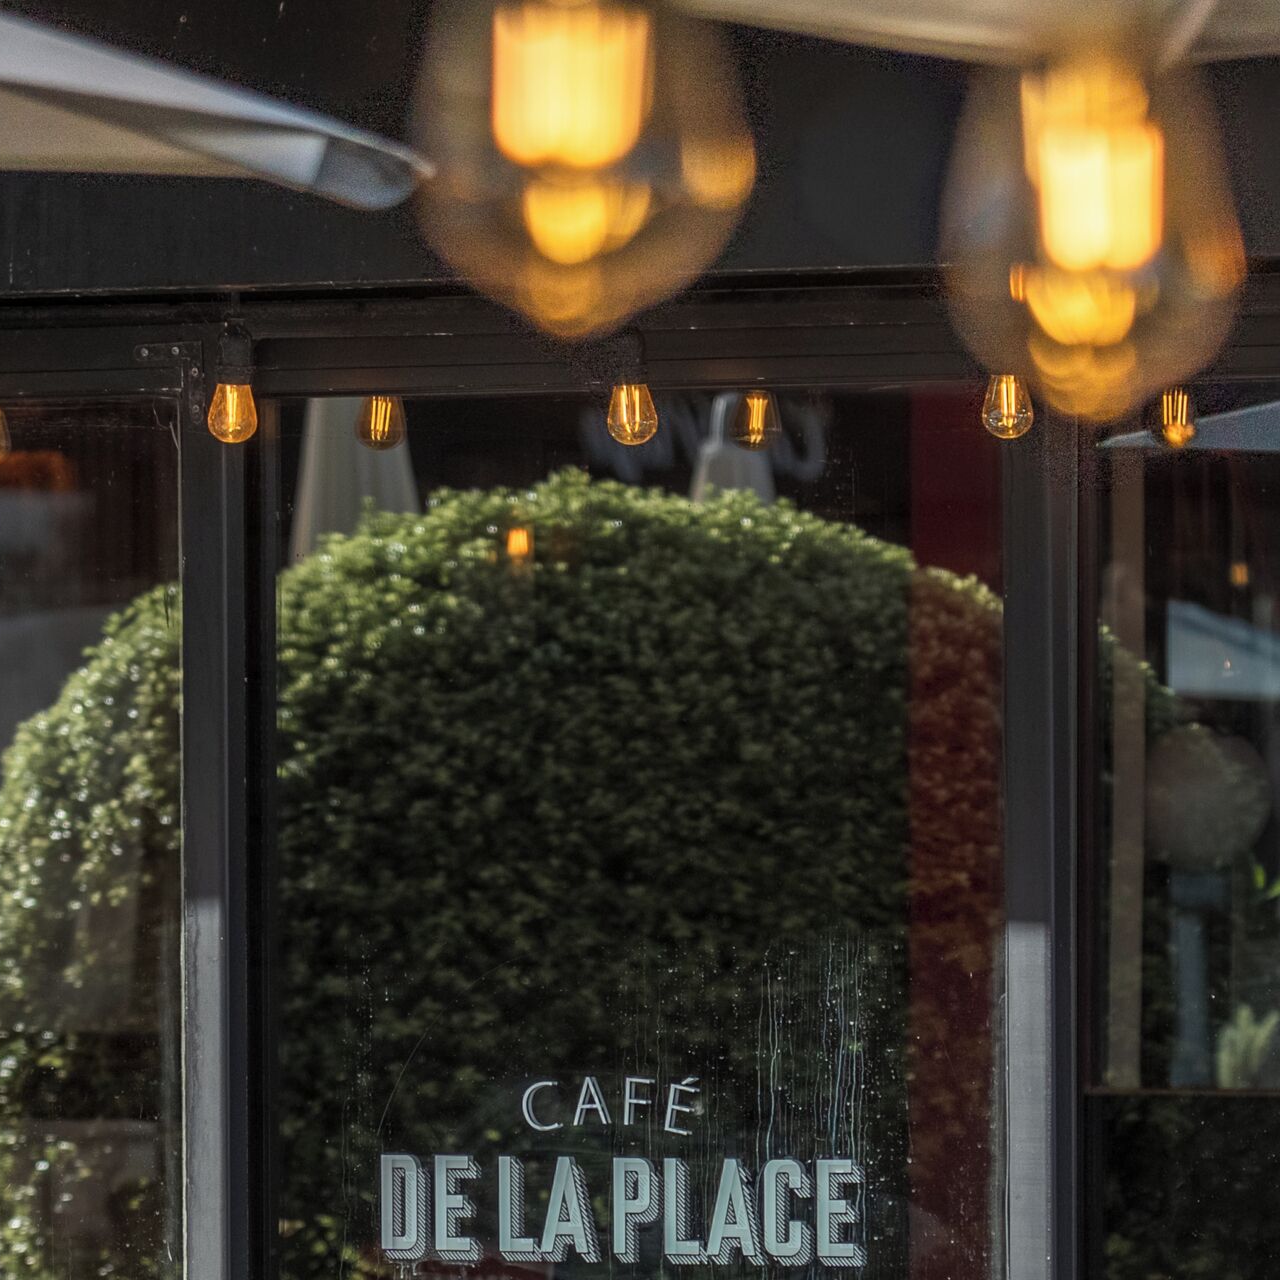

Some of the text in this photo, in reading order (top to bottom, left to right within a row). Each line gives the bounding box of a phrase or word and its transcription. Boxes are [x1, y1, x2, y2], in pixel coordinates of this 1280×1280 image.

[522, 1077, 700, 1135] CAFÉ
[380, 1154, 867, 1267] DE LA PLACE
